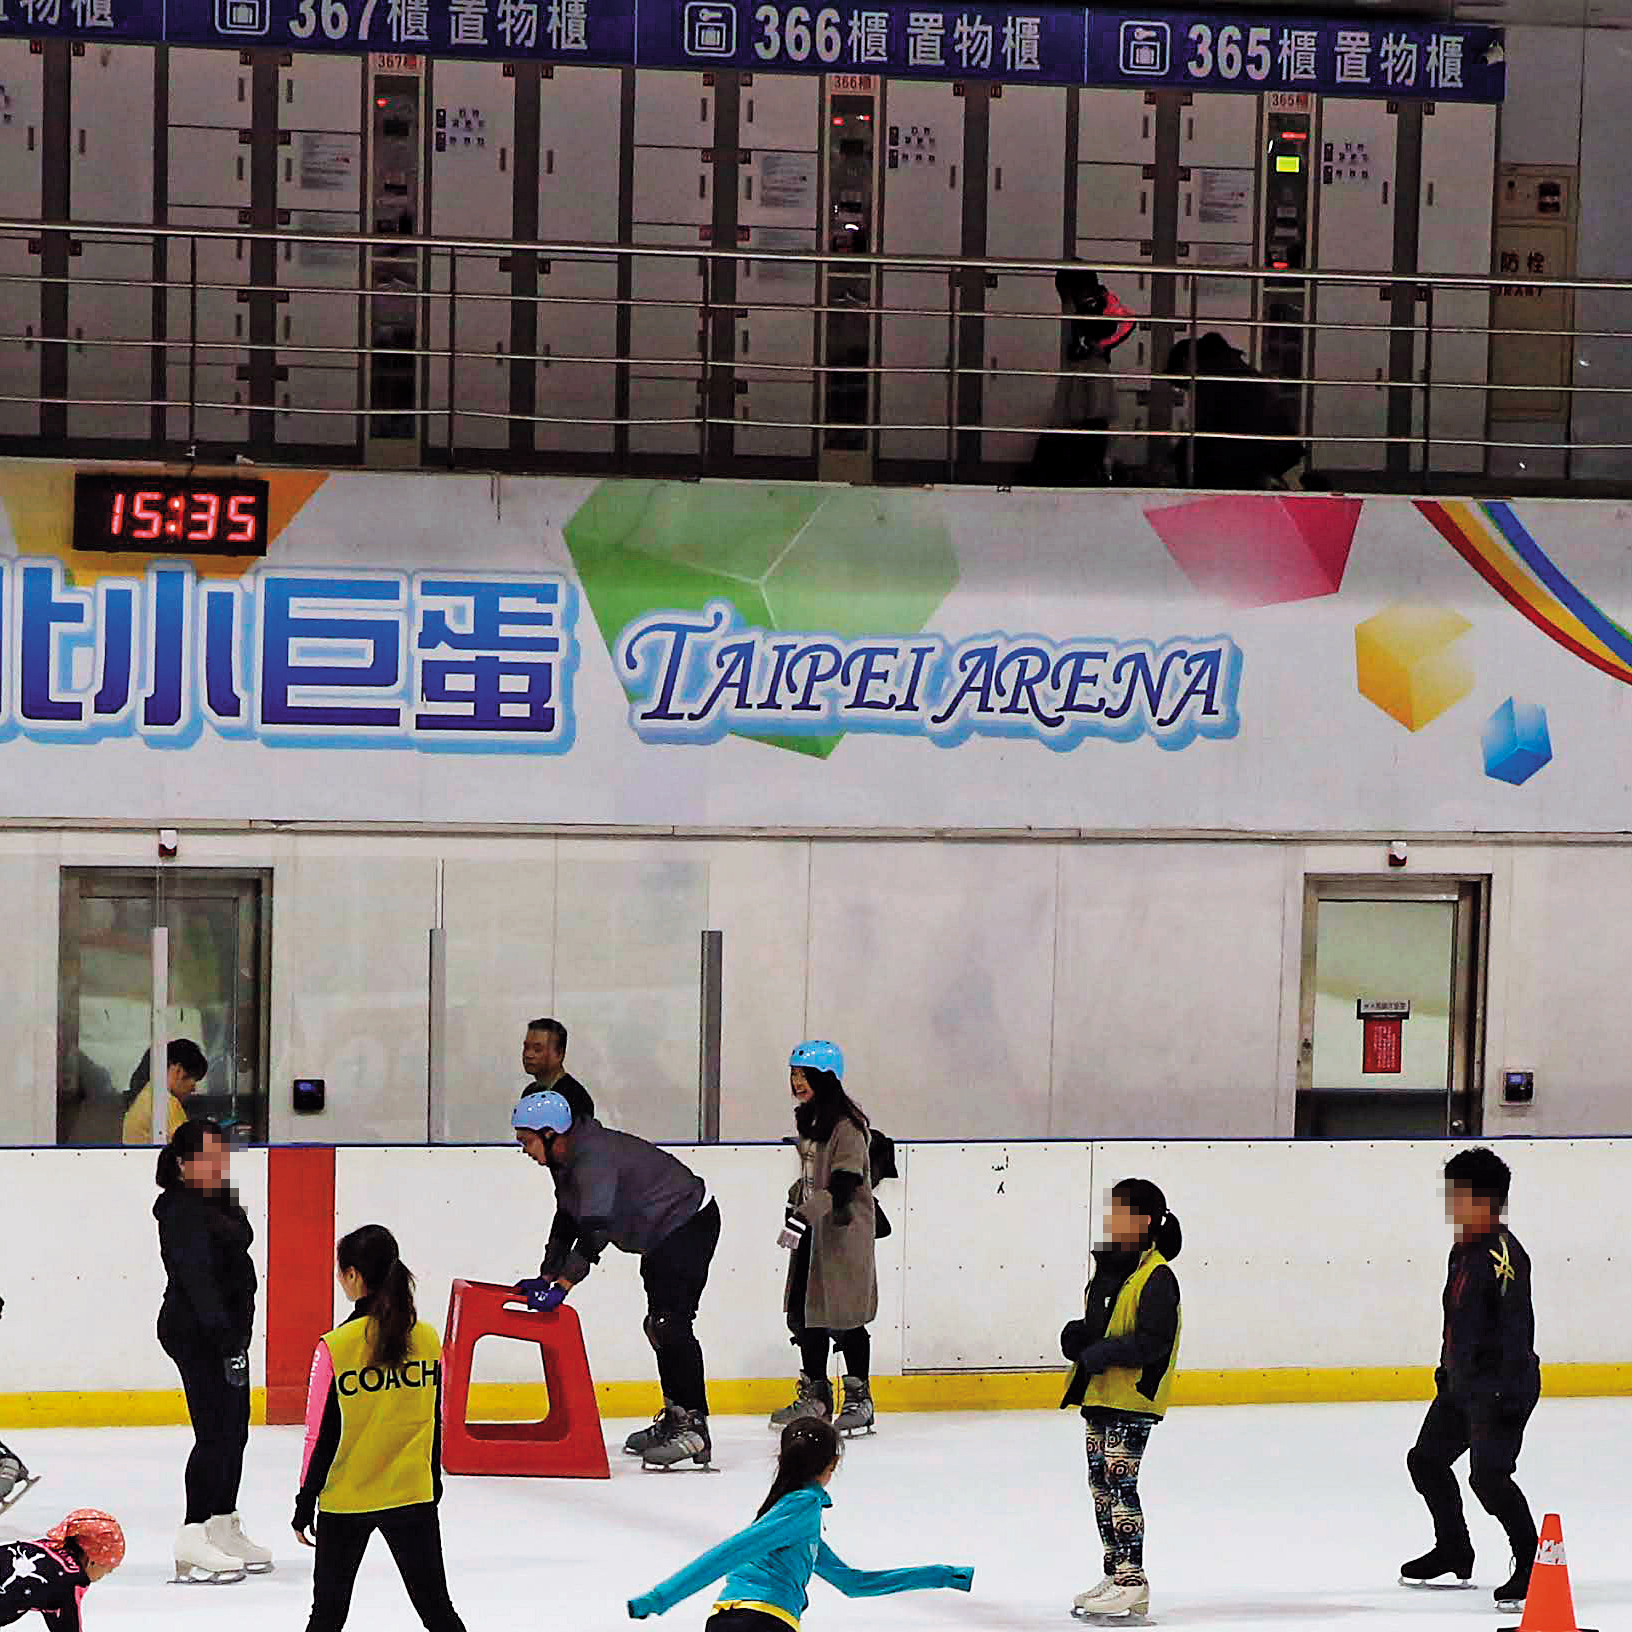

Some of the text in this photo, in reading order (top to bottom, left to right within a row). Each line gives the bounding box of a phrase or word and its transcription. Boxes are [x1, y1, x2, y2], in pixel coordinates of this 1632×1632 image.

[448, 0, 589, 50] 置物櫃
[754, 5, 1040, 71] 366櫃 置物櫃
[1187, 24, 1464, 88] 365櫃 置物櫃
[111, 491, 256, 542] 15:35
[625, 609, 1223, 728] TAIPEI ARENA
[338, 1359, 440, 1397] COACH
